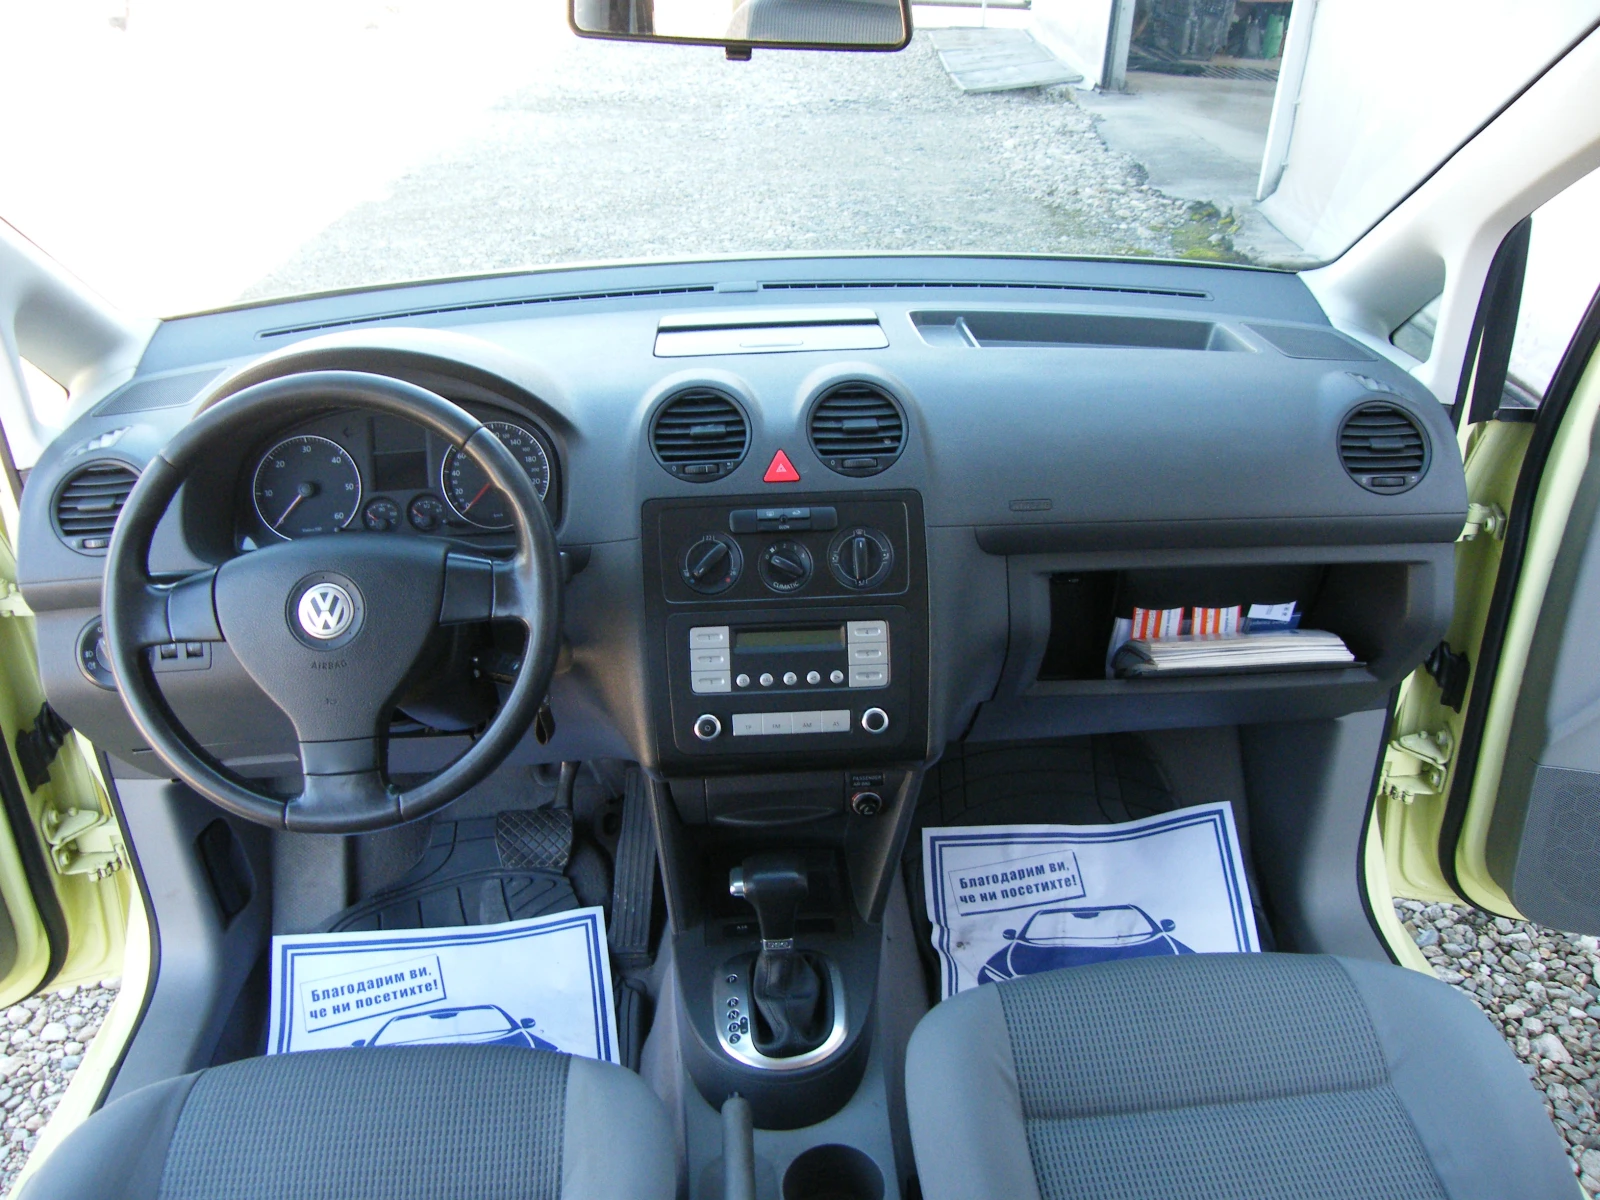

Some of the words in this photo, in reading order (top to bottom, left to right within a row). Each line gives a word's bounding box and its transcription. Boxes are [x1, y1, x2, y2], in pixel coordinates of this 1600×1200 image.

[275, 460, 286, 468] 20
[454, 488, 464, 496] 20
[773, 581, 799, 590] CLIMATIC
[311, 660, 348, 670] AIRBAG
[959, 864, 1045, 889] Благодарим
[959, 893, 976, 904] че
[980, 891, 997, 902] ни
[1000, 874, 1077, 899] посетихте!
[311, 972, 405, 1002] Благодарим
[309, 1007, 327, 1019] че
[332, 1002, 351, 1015] ни
[355, 979, 438, 1009] посетихте!
